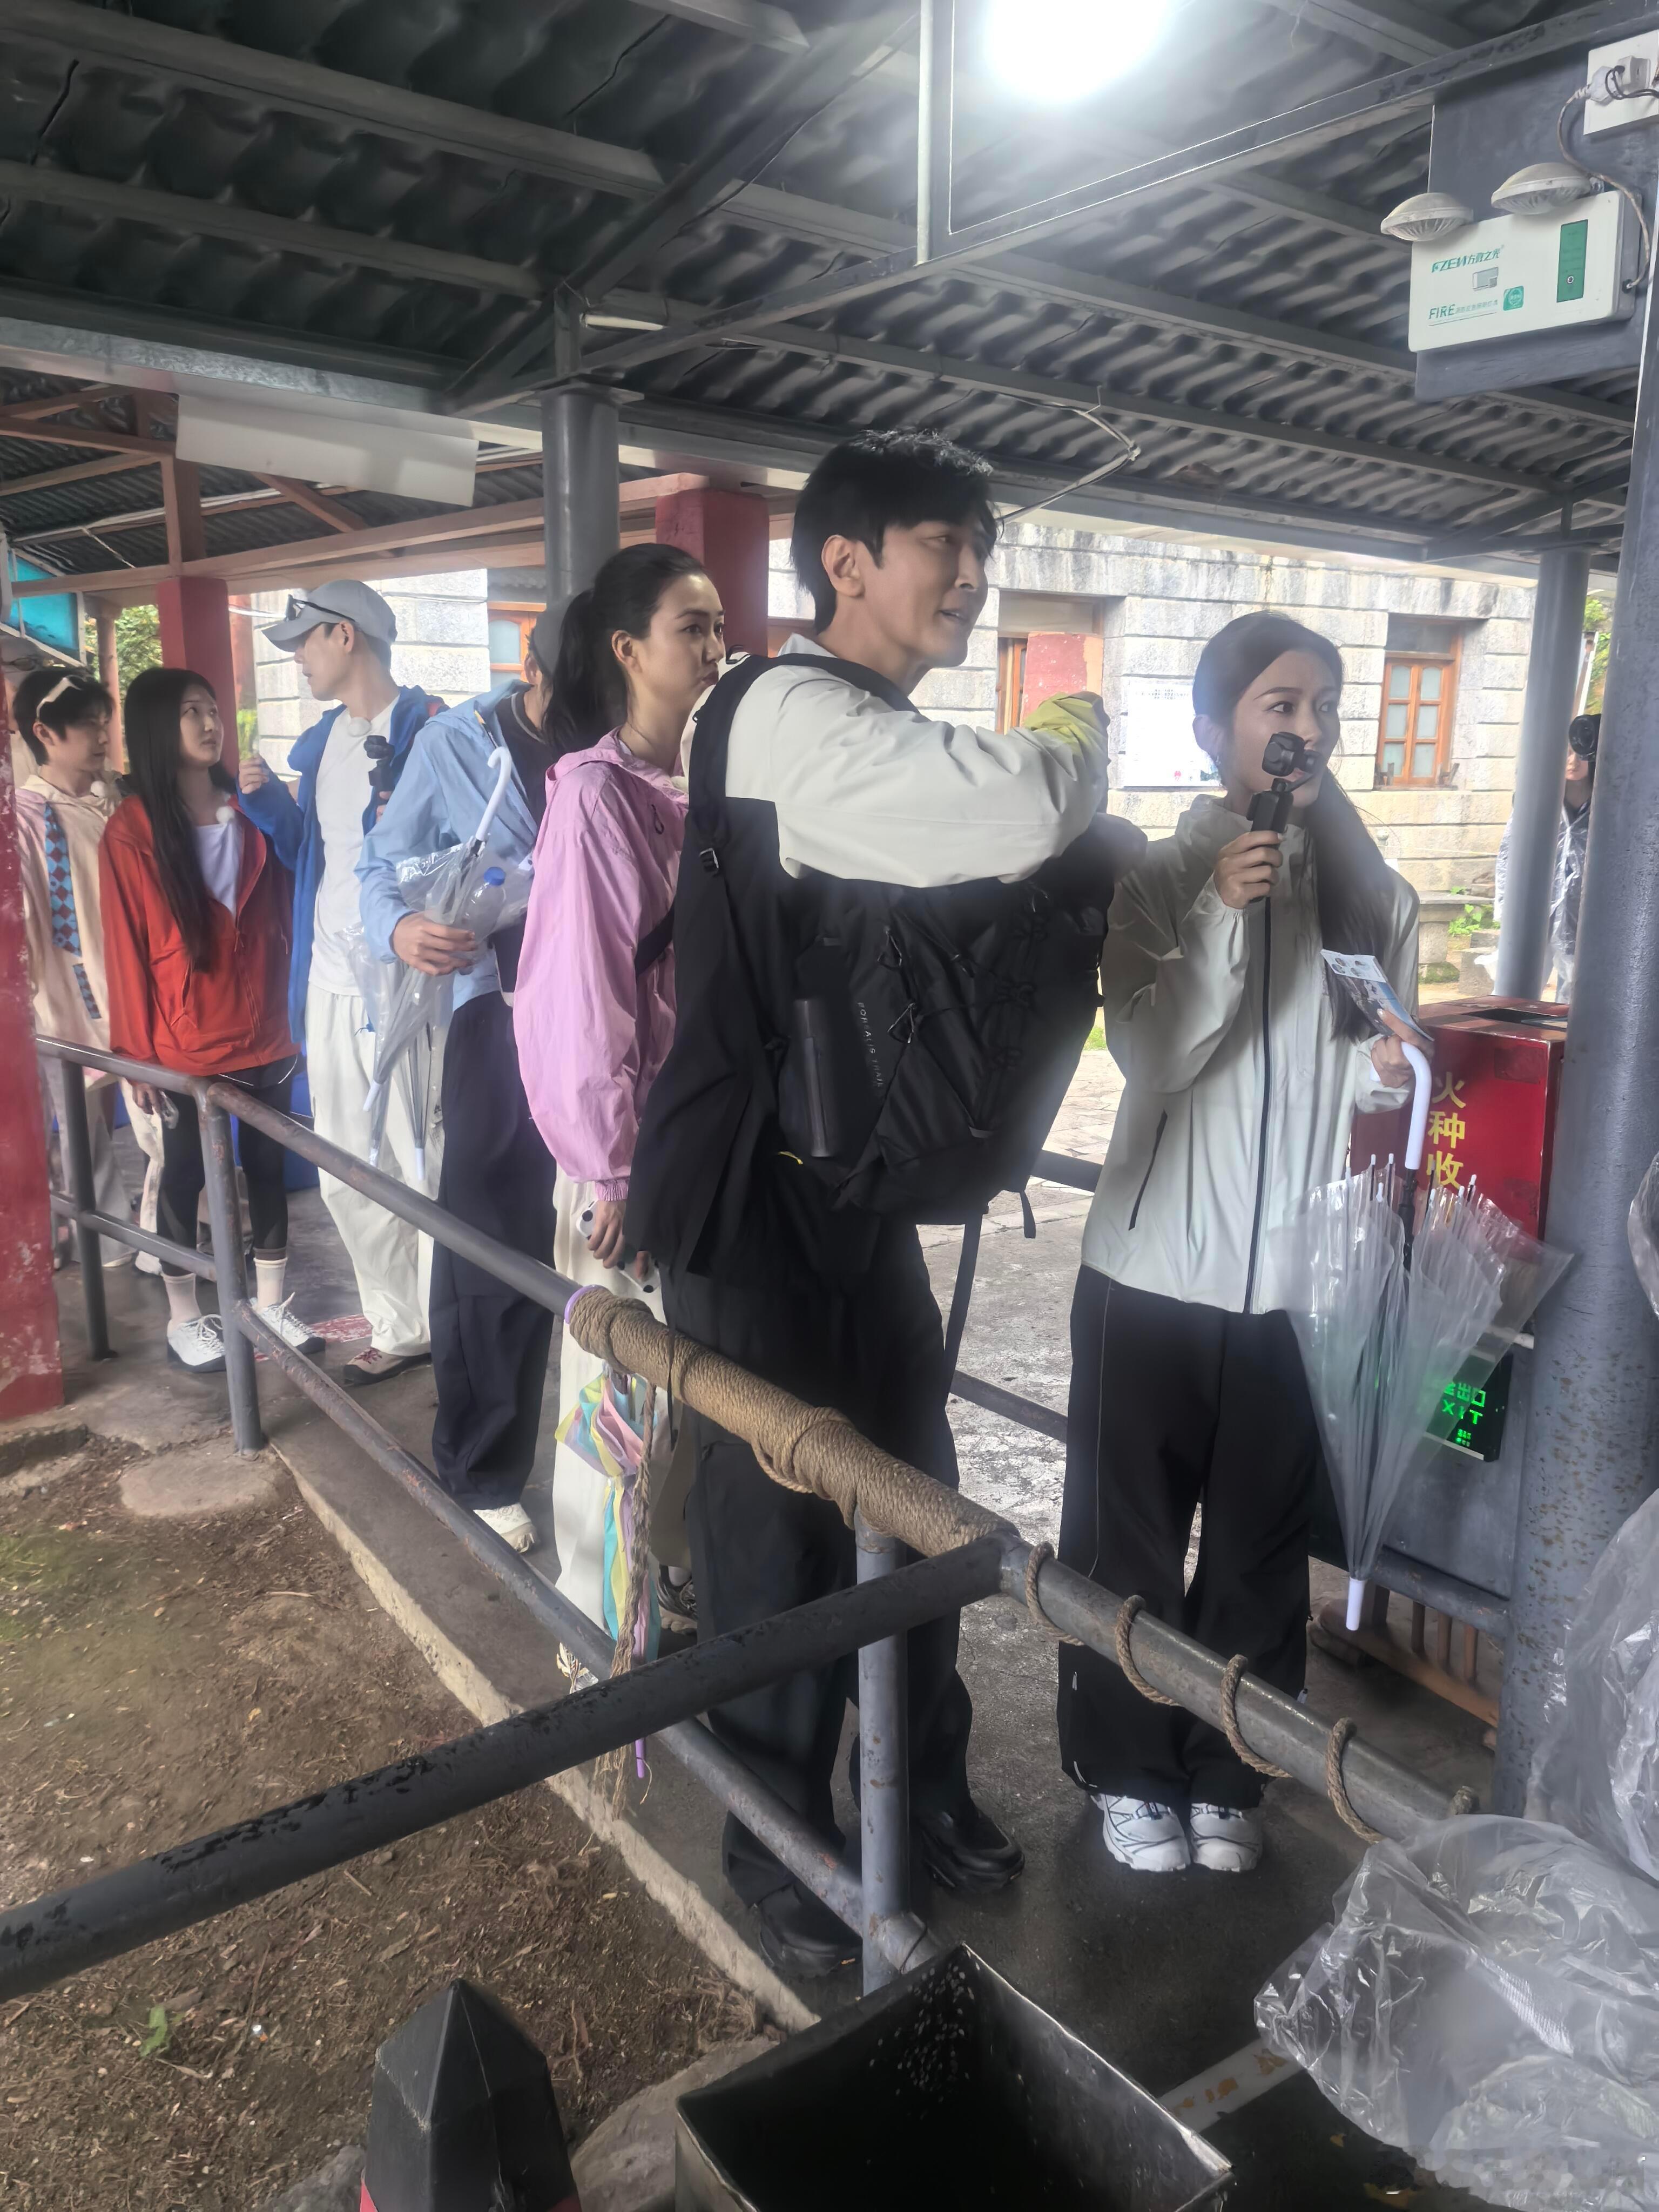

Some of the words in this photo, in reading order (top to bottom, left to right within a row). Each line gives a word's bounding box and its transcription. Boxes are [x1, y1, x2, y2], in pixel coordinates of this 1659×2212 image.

[1428, 304, 1456, 319] FIRE
[1426, 1071, 1466, 1190] 火种收
[1441, 1399, 1483, 1424] XIT
